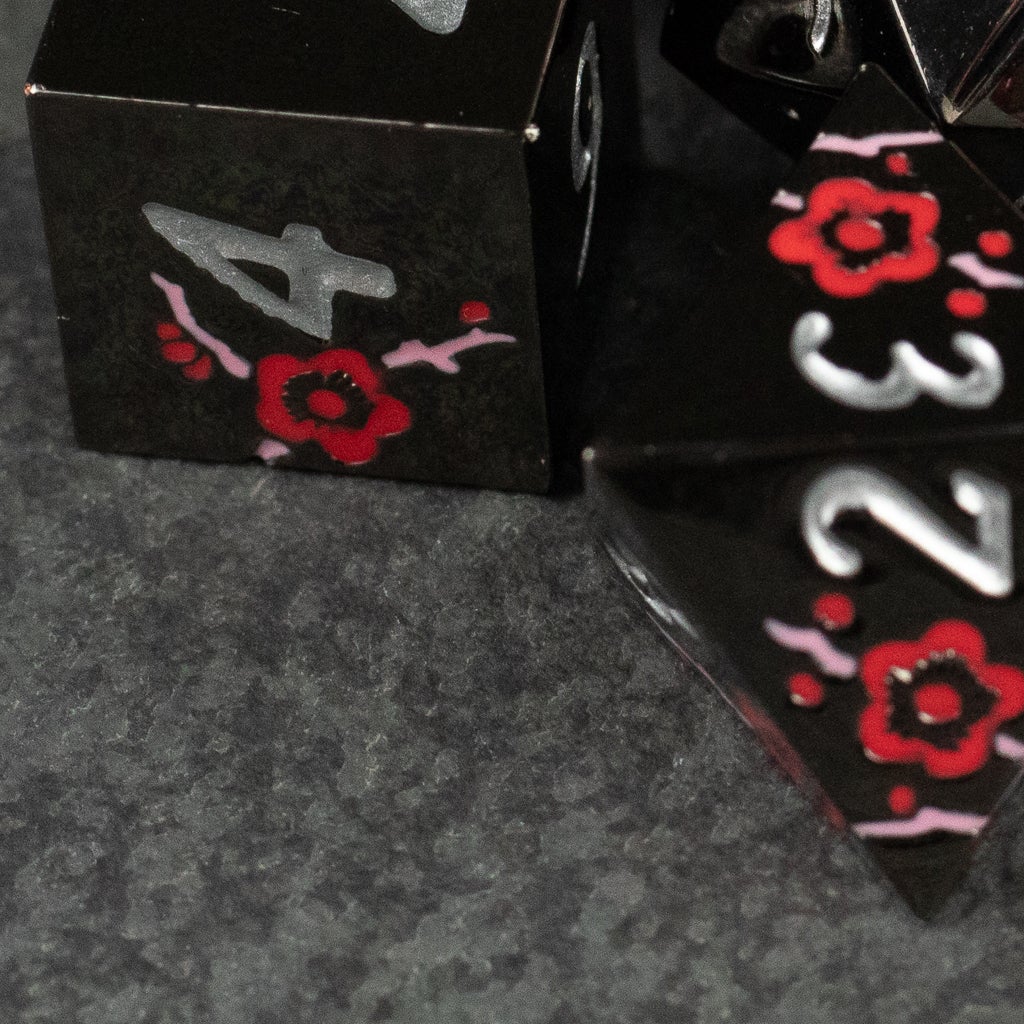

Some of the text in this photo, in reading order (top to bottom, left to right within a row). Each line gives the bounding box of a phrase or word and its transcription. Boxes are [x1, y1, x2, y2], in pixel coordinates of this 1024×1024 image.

[142, 201, 397, 340] 4
[791, 311, 1006, 411] 3
[801, 464, 1016, 598] 2
